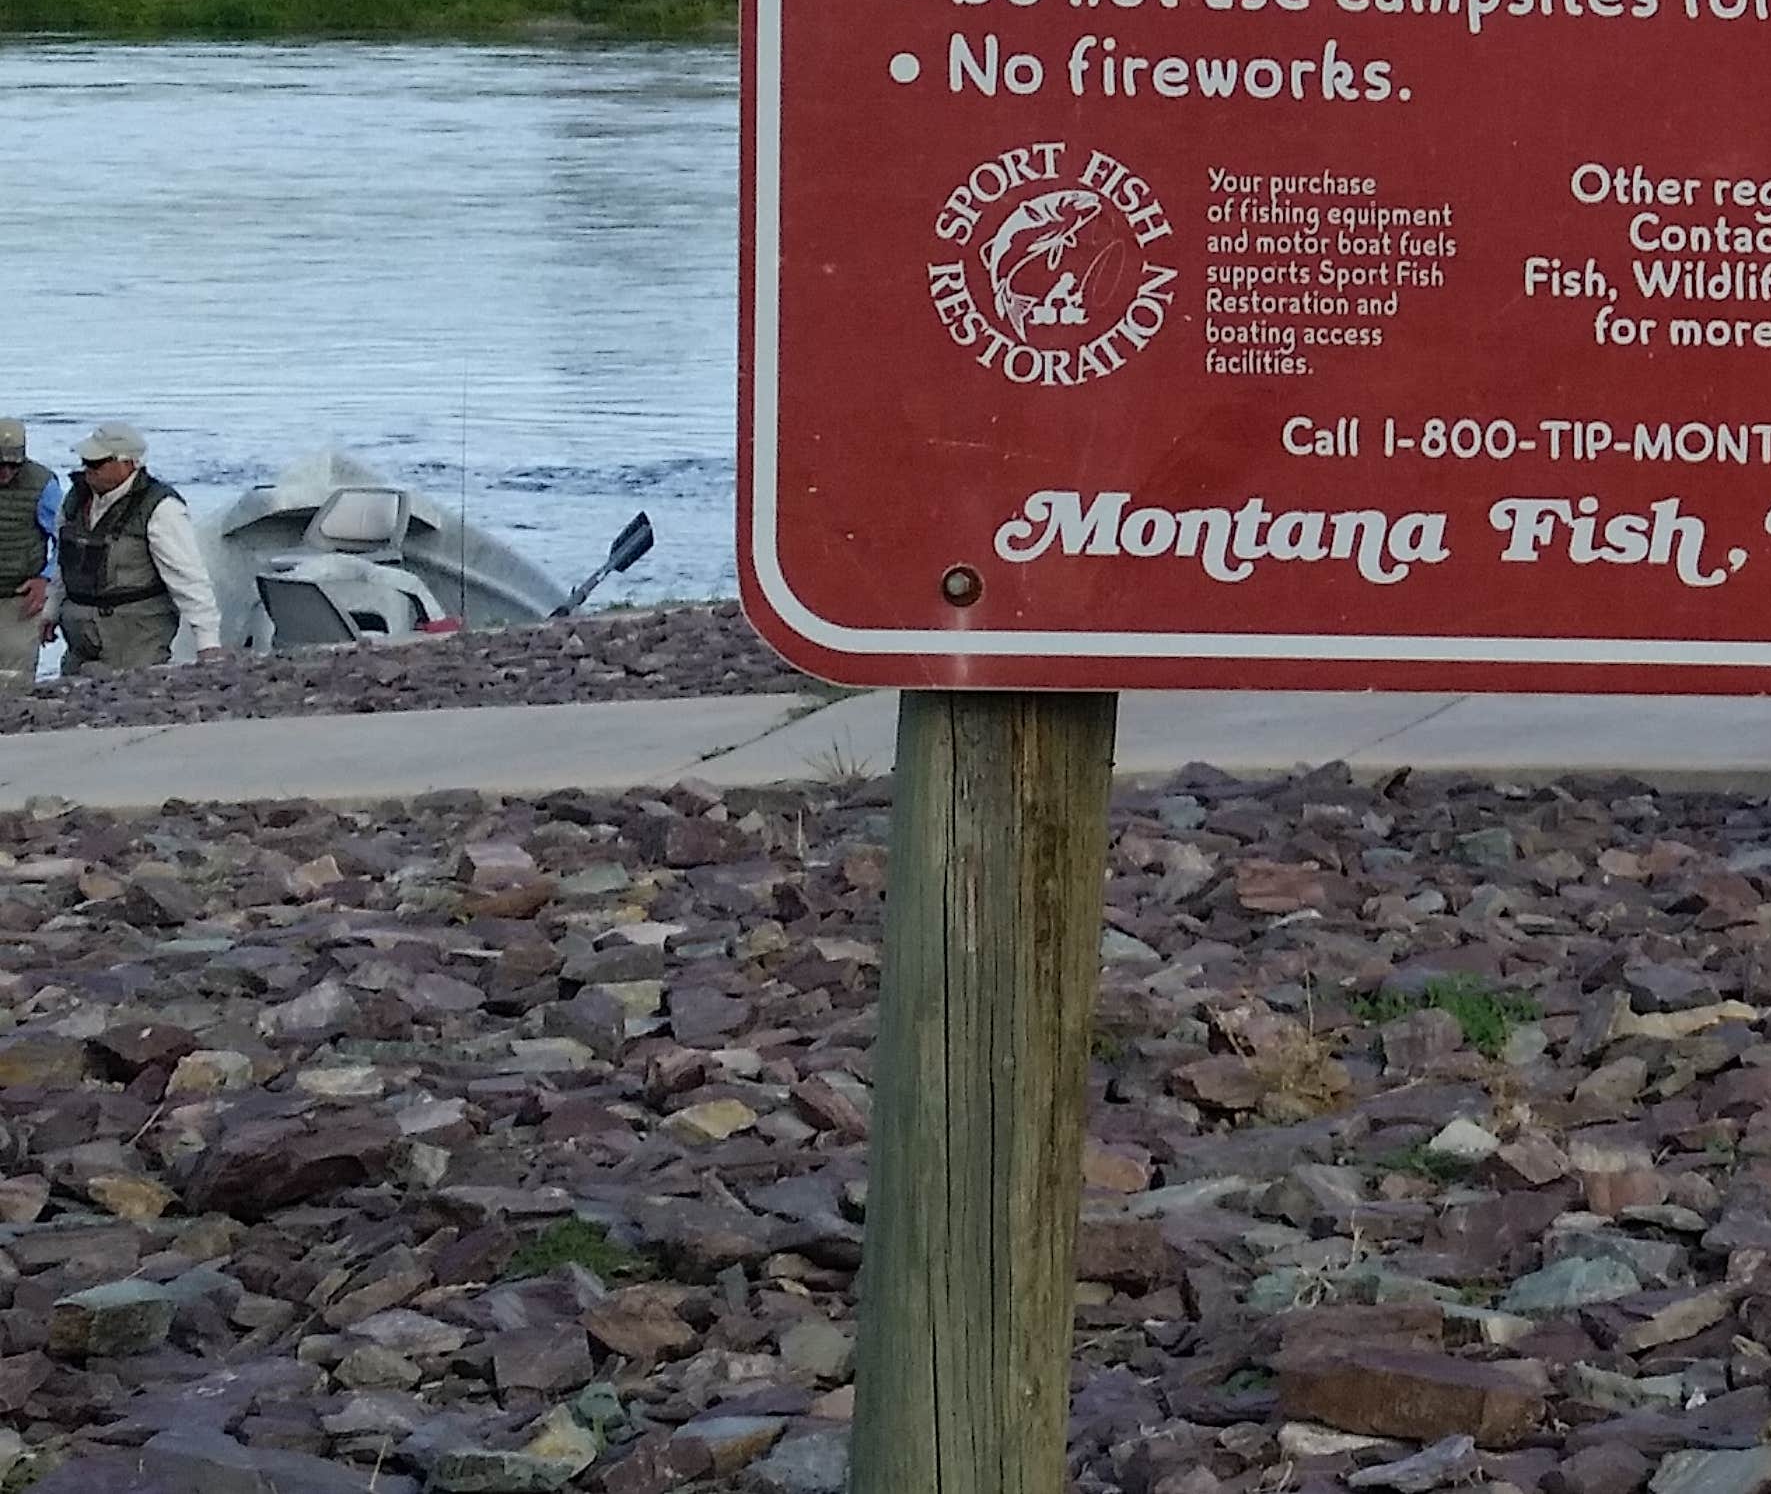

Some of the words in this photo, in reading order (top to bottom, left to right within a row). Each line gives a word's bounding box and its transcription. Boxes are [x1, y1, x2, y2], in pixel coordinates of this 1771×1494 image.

[948, 32, 1044, 97] No
[1067, 34, 1412, 102] fireworks.
[935, 141, 1067, 247] SPORT
[1077, 149, 1174, 249] FISH
[1207, 166, 1264, 194] Your
[1269, 168, 1377, 202] purchase
[1570, 162, 1702, 206] Other
[1206, 196, 1235, 224] of
[1238, 197, 1321, 236] fishing
[1326, 200, 1453, 235] equipment
[1206, 227, 1249, 254] and
[1255, 230, 1331, 255] motor
[1337, 229, 1392, 256] boat
[1399, 229, 1457, 258] fuels
[1206, 259, 1311, 292] supports
[1317, 259, 1390, 293] Sport
[1396, 260, 1445, 287] Fish
[1524, 256, 1618, 303] Fish,
[1205, 286, 1350, 316] Restoration
[1356, 290, 1399, 317] and
[926, 259, 1179, 387] RESTORATION
[1205, 317, 1296, 357] boating
[1302, 326, 1383, 347] access
[1593, 304, 1658, 346] for
[1205, 347, 1314, 376] facilities.
[1281, 416, 1360, 458] Call
[993, 489, 1451, 585] Montana
[1488, 495, 1749, 587] Fish,
